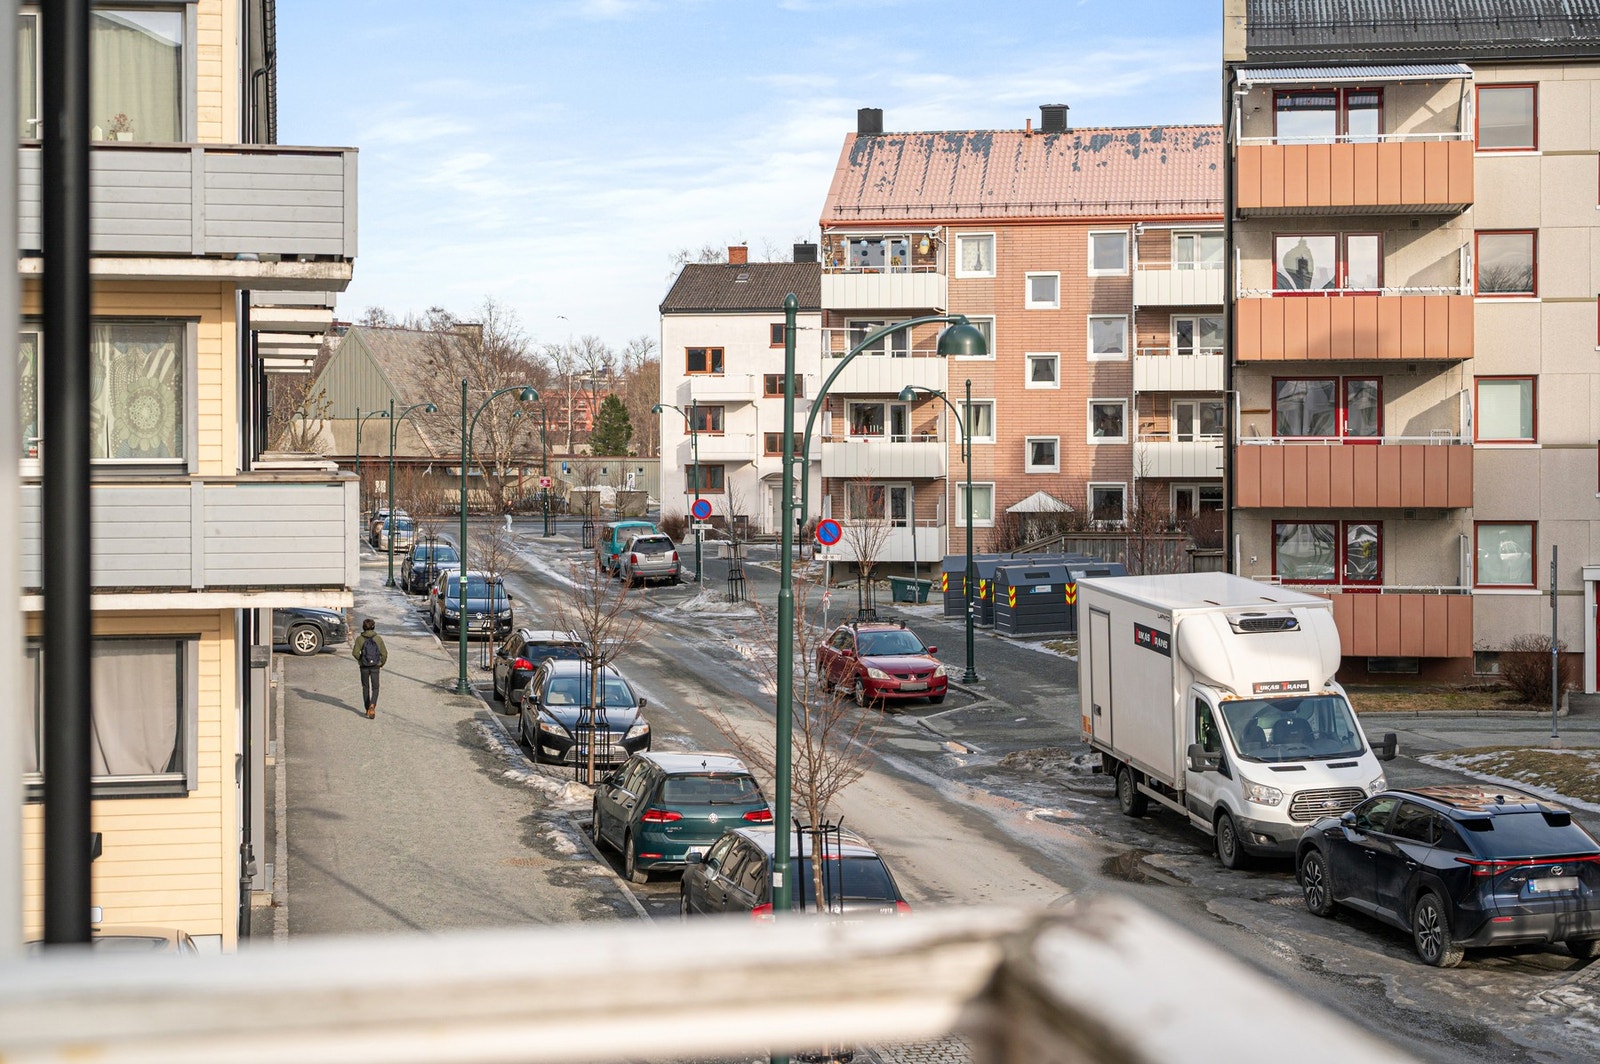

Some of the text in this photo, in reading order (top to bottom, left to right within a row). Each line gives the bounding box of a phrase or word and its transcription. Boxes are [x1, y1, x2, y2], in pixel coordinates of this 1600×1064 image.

[1135, 628, 1168, 649] LUKAS TRANS
[1255, 681, 1308, 693] LUKAS TRANS
